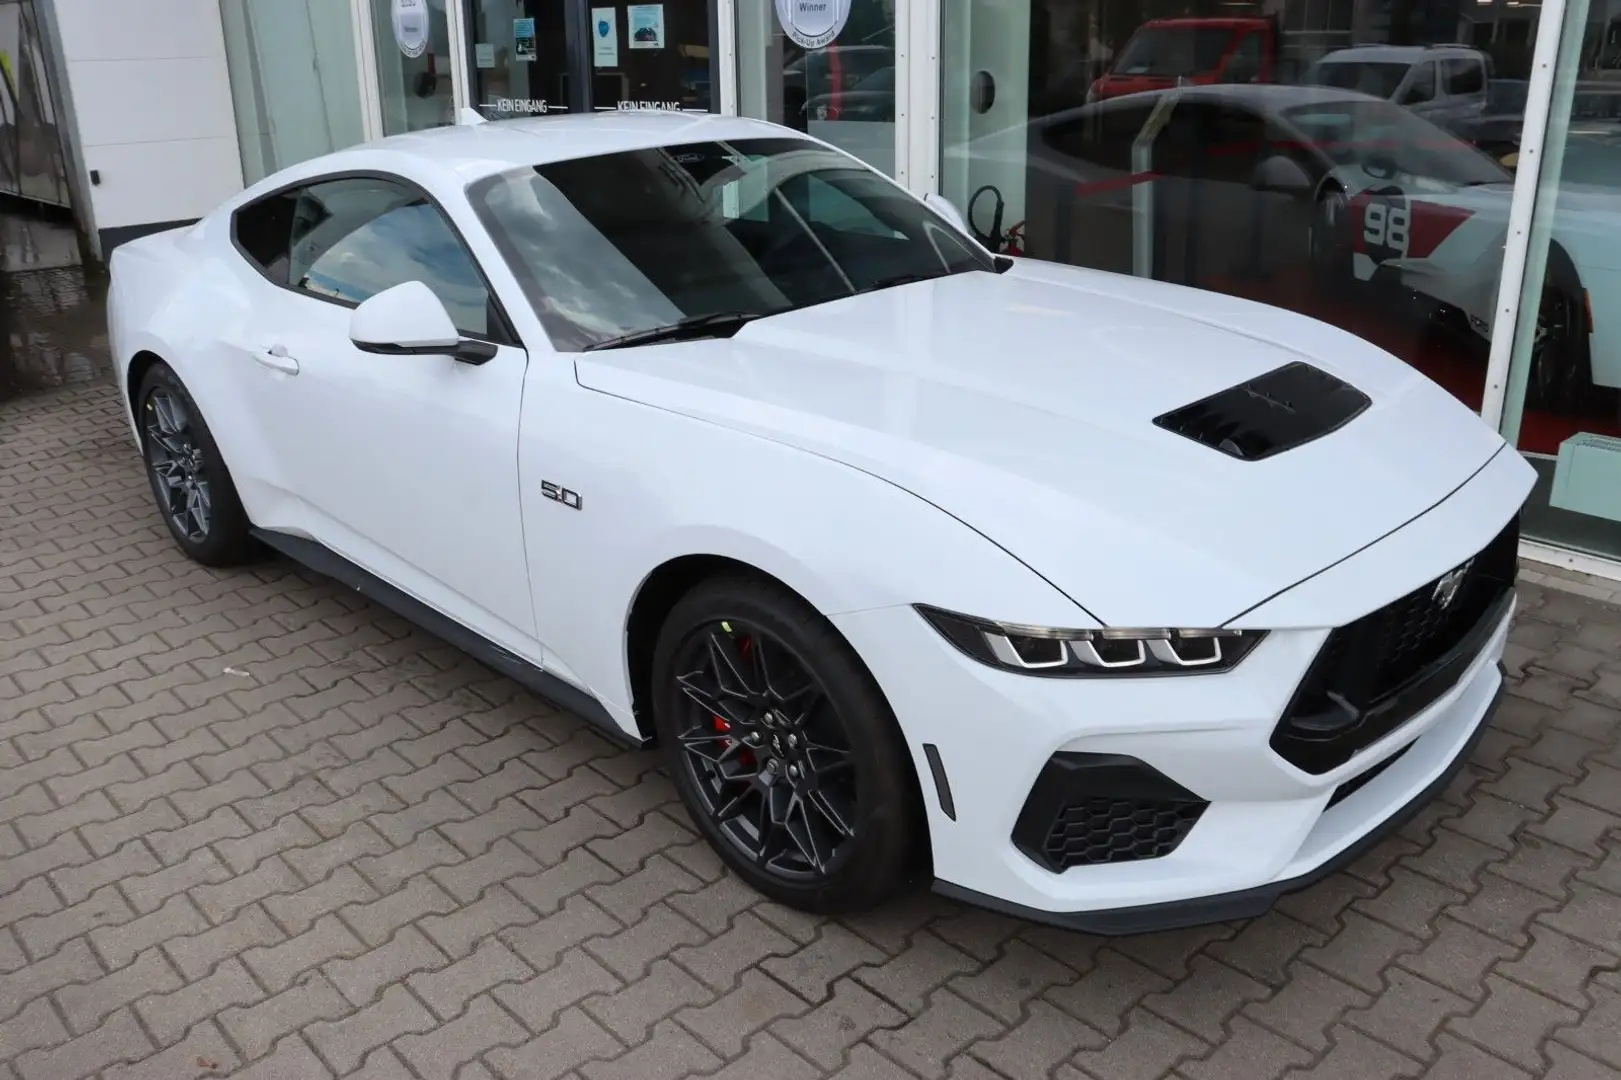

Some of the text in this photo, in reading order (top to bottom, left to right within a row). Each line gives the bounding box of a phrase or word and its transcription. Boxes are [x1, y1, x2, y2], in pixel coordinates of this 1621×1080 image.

[799, 3, 827, 12] Winner
[792, 30, 835, 46] Pick-Up Award
[497, 99, 548, 113] KEIN EINGANG
[617, 100, 638, 111] KEIN
[1364, 203, 1409, 251] 98
[541, 480, 582, 511] 5.0
